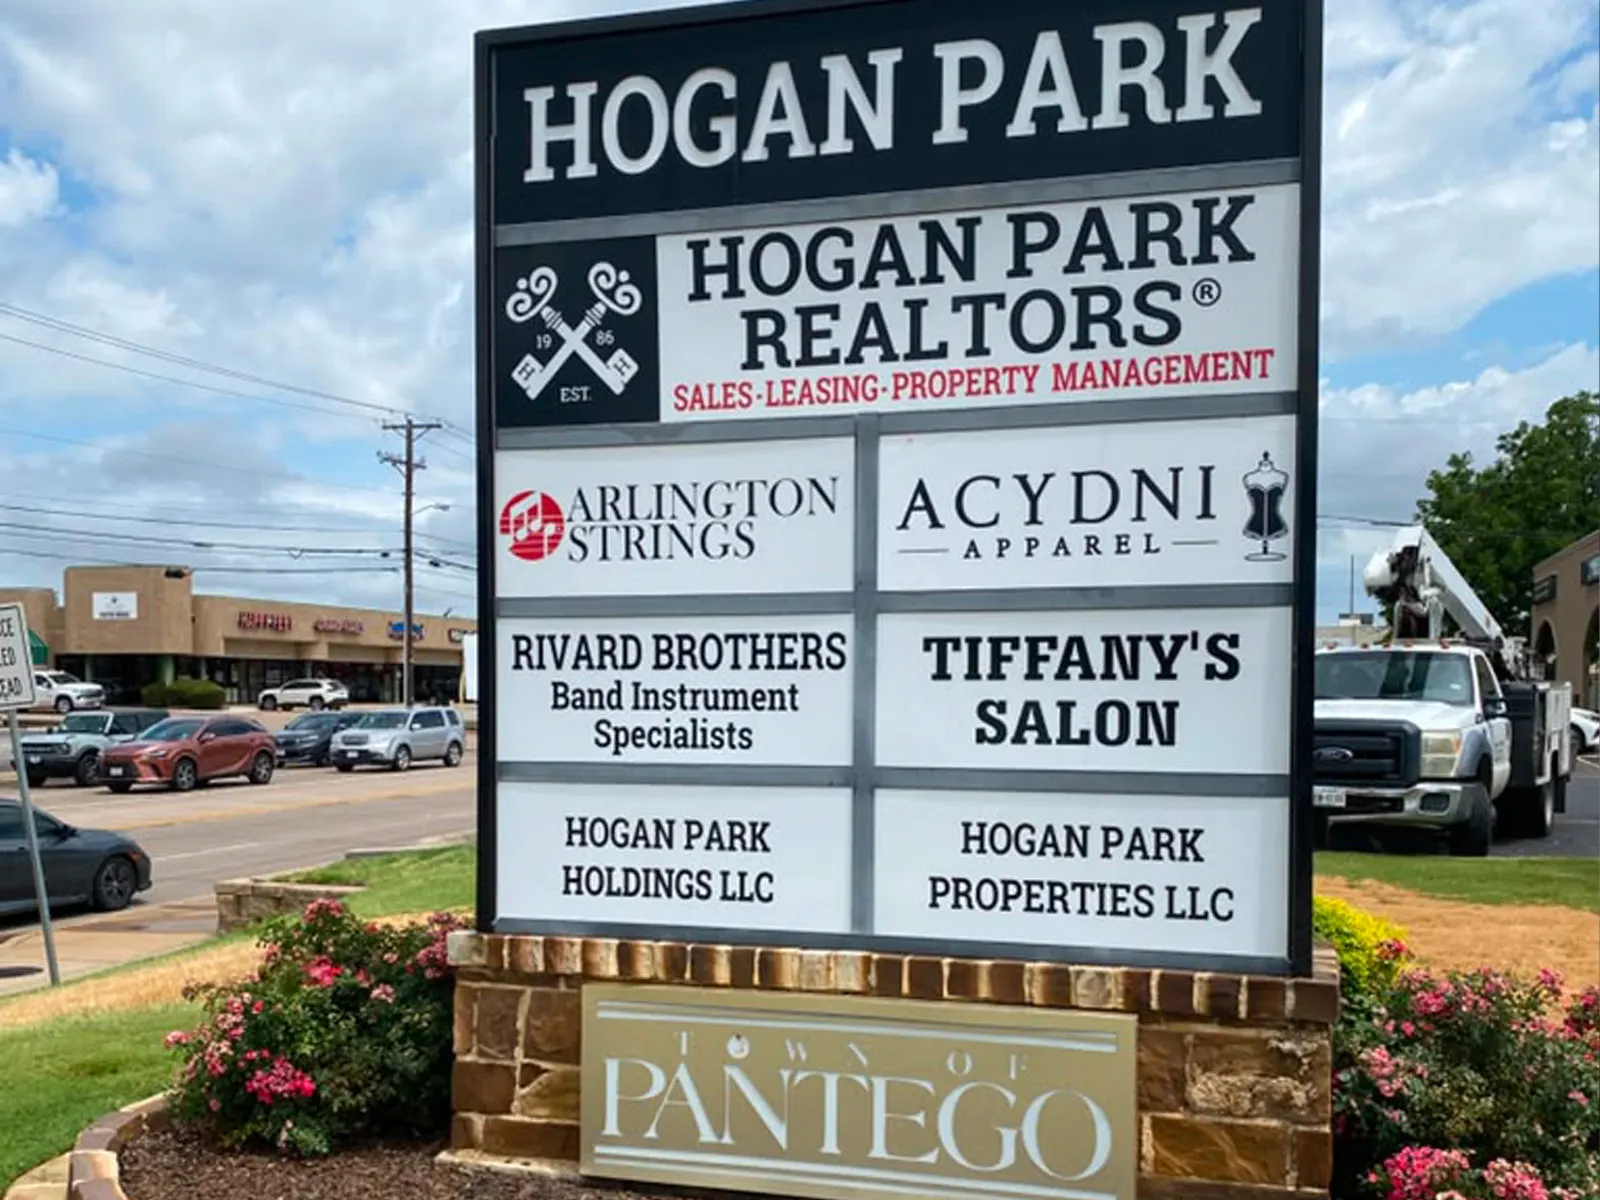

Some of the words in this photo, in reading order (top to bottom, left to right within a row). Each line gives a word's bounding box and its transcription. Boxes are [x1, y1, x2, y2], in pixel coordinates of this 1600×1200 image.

[523, 47, 903, 184] HOGAN
[932, 7, 1262, 144] PARK
[686, 215, 983, 303] HOGAN
[1006, 194, 1256, 279] PARK
[535, 333, 553, 350] 19
[1052, 348, 1275, 393] MANAGEMENT
[566, 476, 838, 523] ARLINGTON
[896, 465, 1217, 531] ACYDNI
[568, 521, 755, 562] STRINGS
[963, 533, 1161, 559] APPAREL
[511, 633, 643, 671] RIVARD
[651, 631, 847, 671] BROTHERS
[922, 630, 1240, 681] TIFFANY'S
[550, 680, 623, 711] Band
[631, 681, 799, 712] Instrument
[594, 717, 753, 756] Specialists
[975, 699, 1180, 747] SALON
[565, 816, 676, 850] HOGAN
[683, 819, 771, 853] PARK
[961, 821, 1091, 859] HOGAN
[1100, 825, 1206, 863] PARK
[562, 865, 713, 901] HOLDINGS
[719, 870, 774, 904] LLC
[928, 876, 1155, 919] PROPERTIES
[1165, 885, 1234, 922] LLC
[602, 1057, 1112, 1180] PANTEGO
